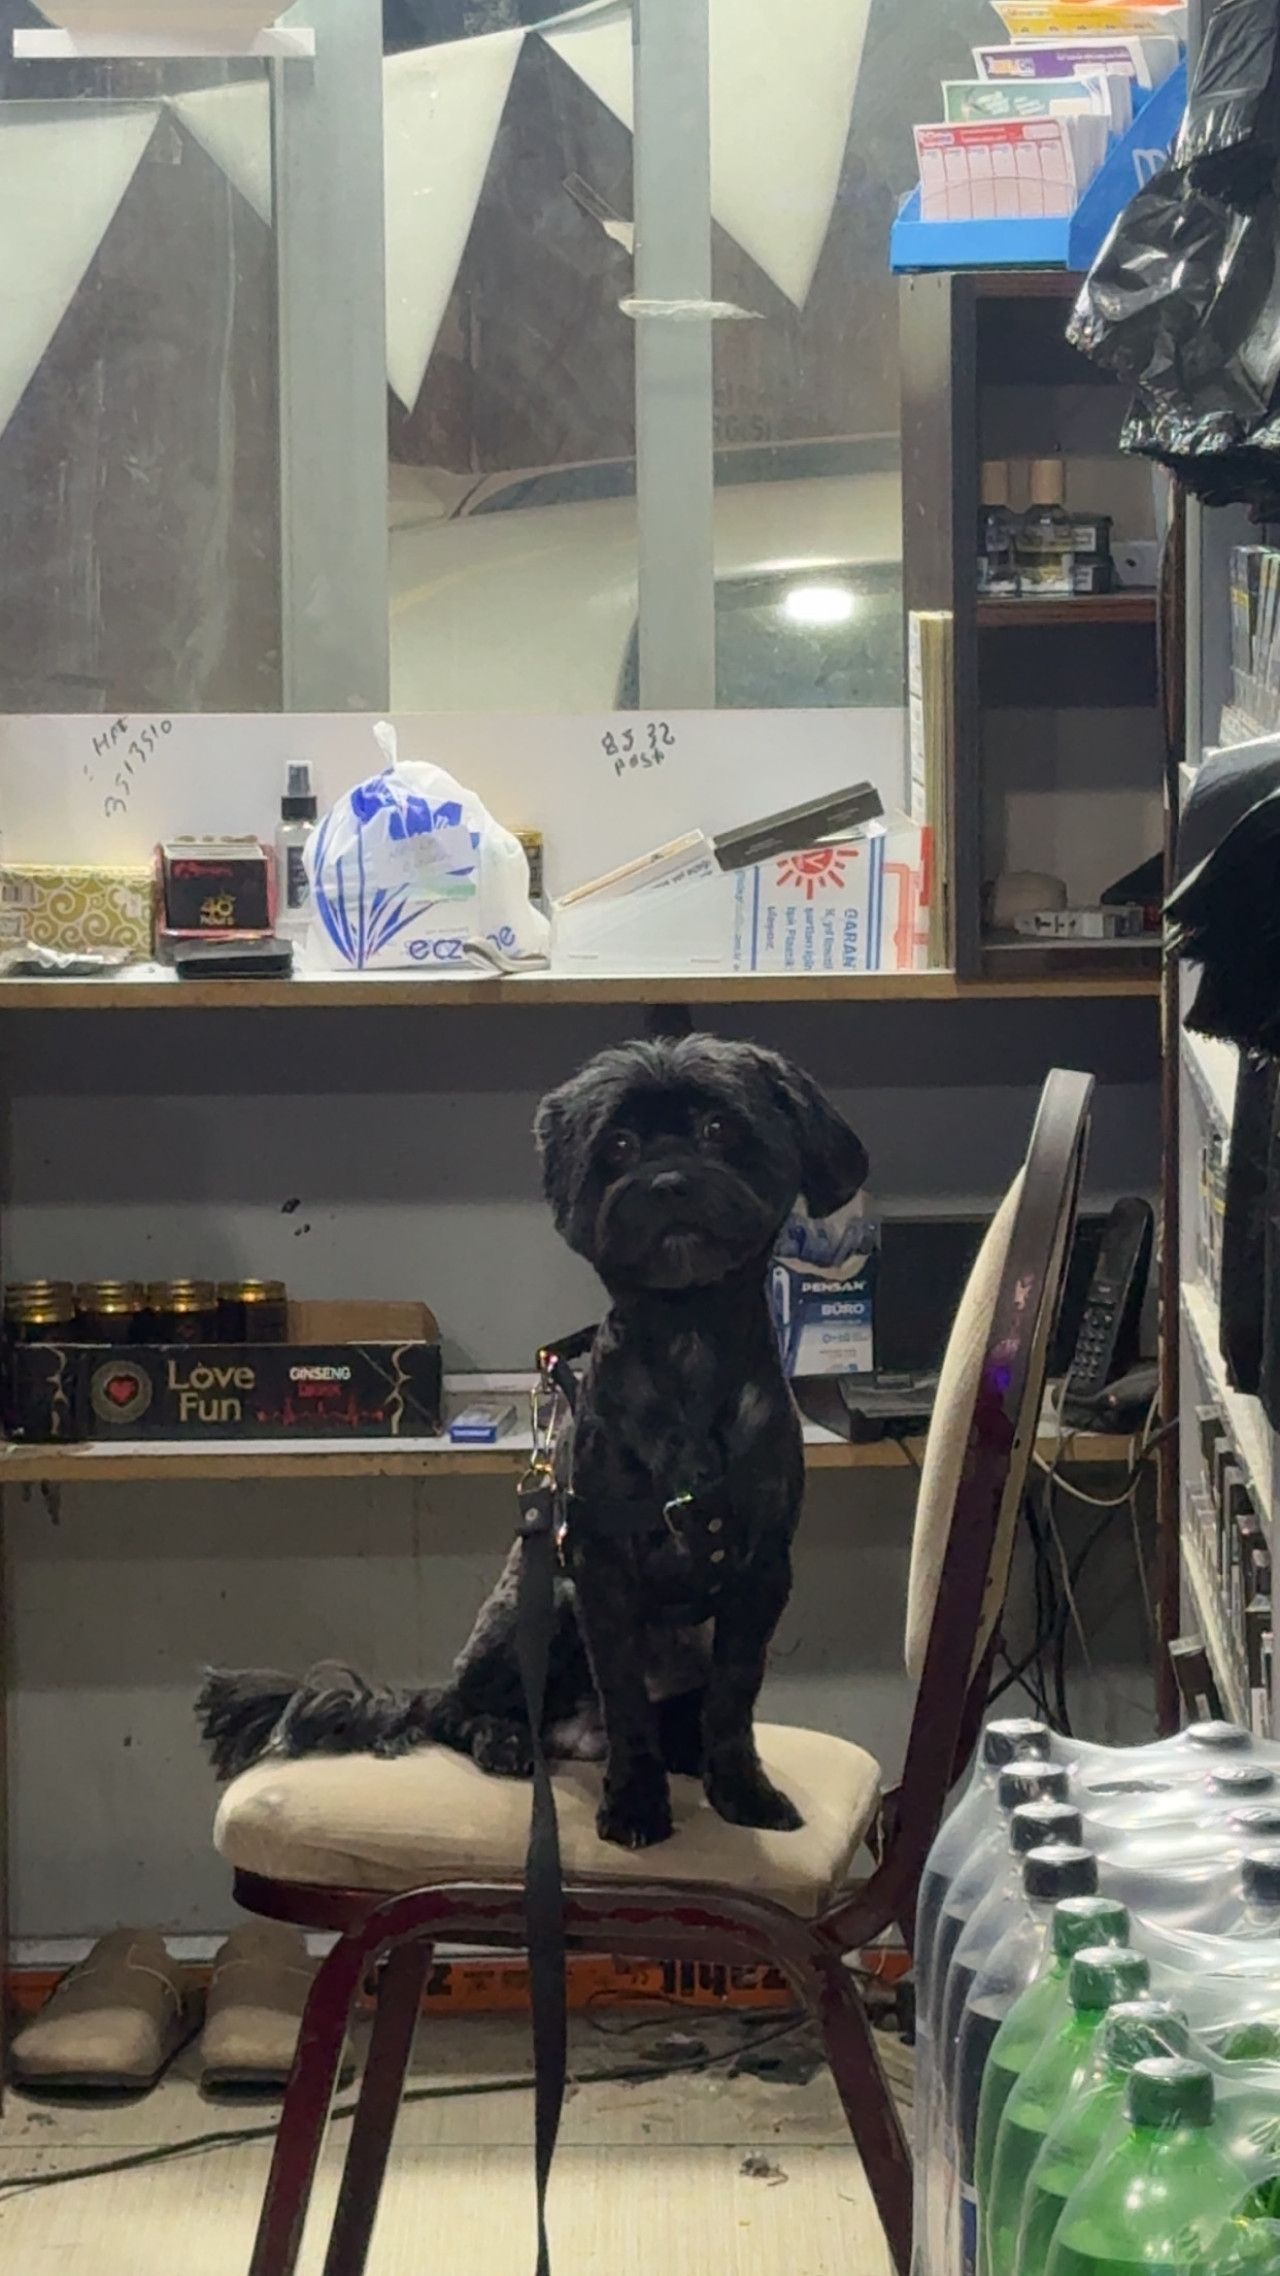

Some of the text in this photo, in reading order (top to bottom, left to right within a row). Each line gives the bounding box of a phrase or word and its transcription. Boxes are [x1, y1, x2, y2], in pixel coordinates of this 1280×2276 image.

[802, 1281, 867, 1293] PENSAN
[821, 1302, 865, 1316] BÜRO
[168, 1359, 255, 1390] Love
[289, 1366, 351, 1381] GINSENG
[179, 1392, 242, 1422] Fun
